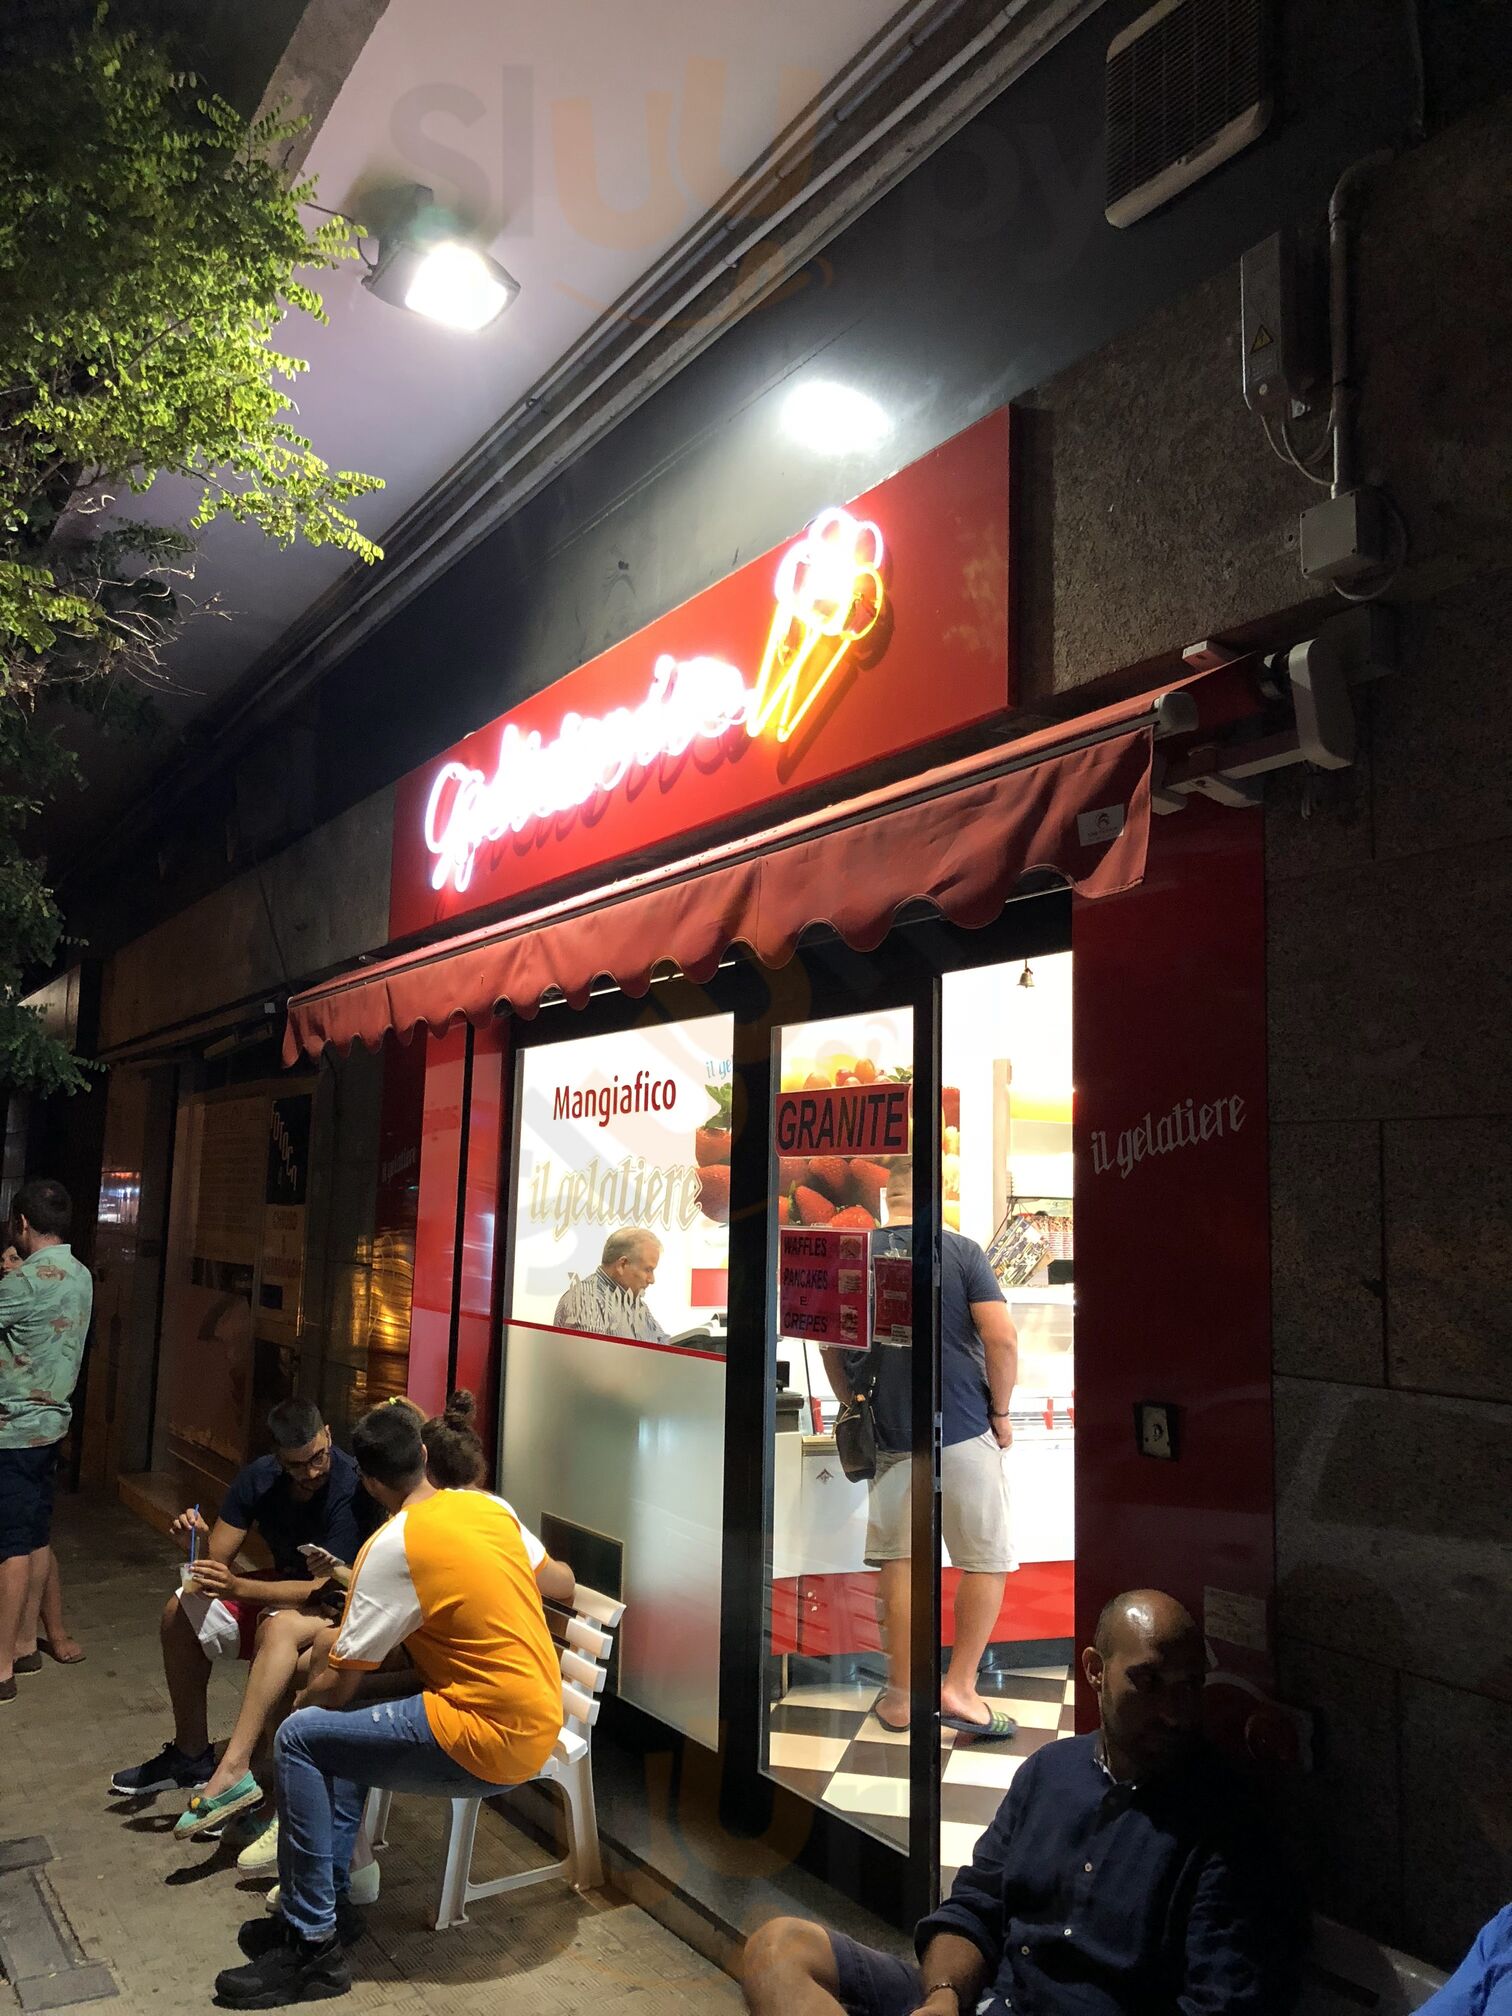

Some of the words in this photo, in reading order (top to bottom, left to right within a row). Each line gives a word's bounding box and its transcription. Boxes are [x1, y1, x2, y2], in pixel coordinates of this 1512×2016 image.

[705, 1060, 716, 1078] il
[553, 1070, 676, 1127] Mangiafico
[777, 1092, 905, 1150] GRANITE
[1090, 1130, 1115, 1175] il
[1117, 1094, 1247, 1179] gelatiere
[529, 1160, 550, 1224] il
[552, 1156, 703, 1241] gelatiere
[783, 1236, 827, 1257] WAFFLES
[783, 1267, 828, 1290] PANCAKES
[800, 1295, 808, 1306] E
[783, 1311, 828, 1333] CREPES
